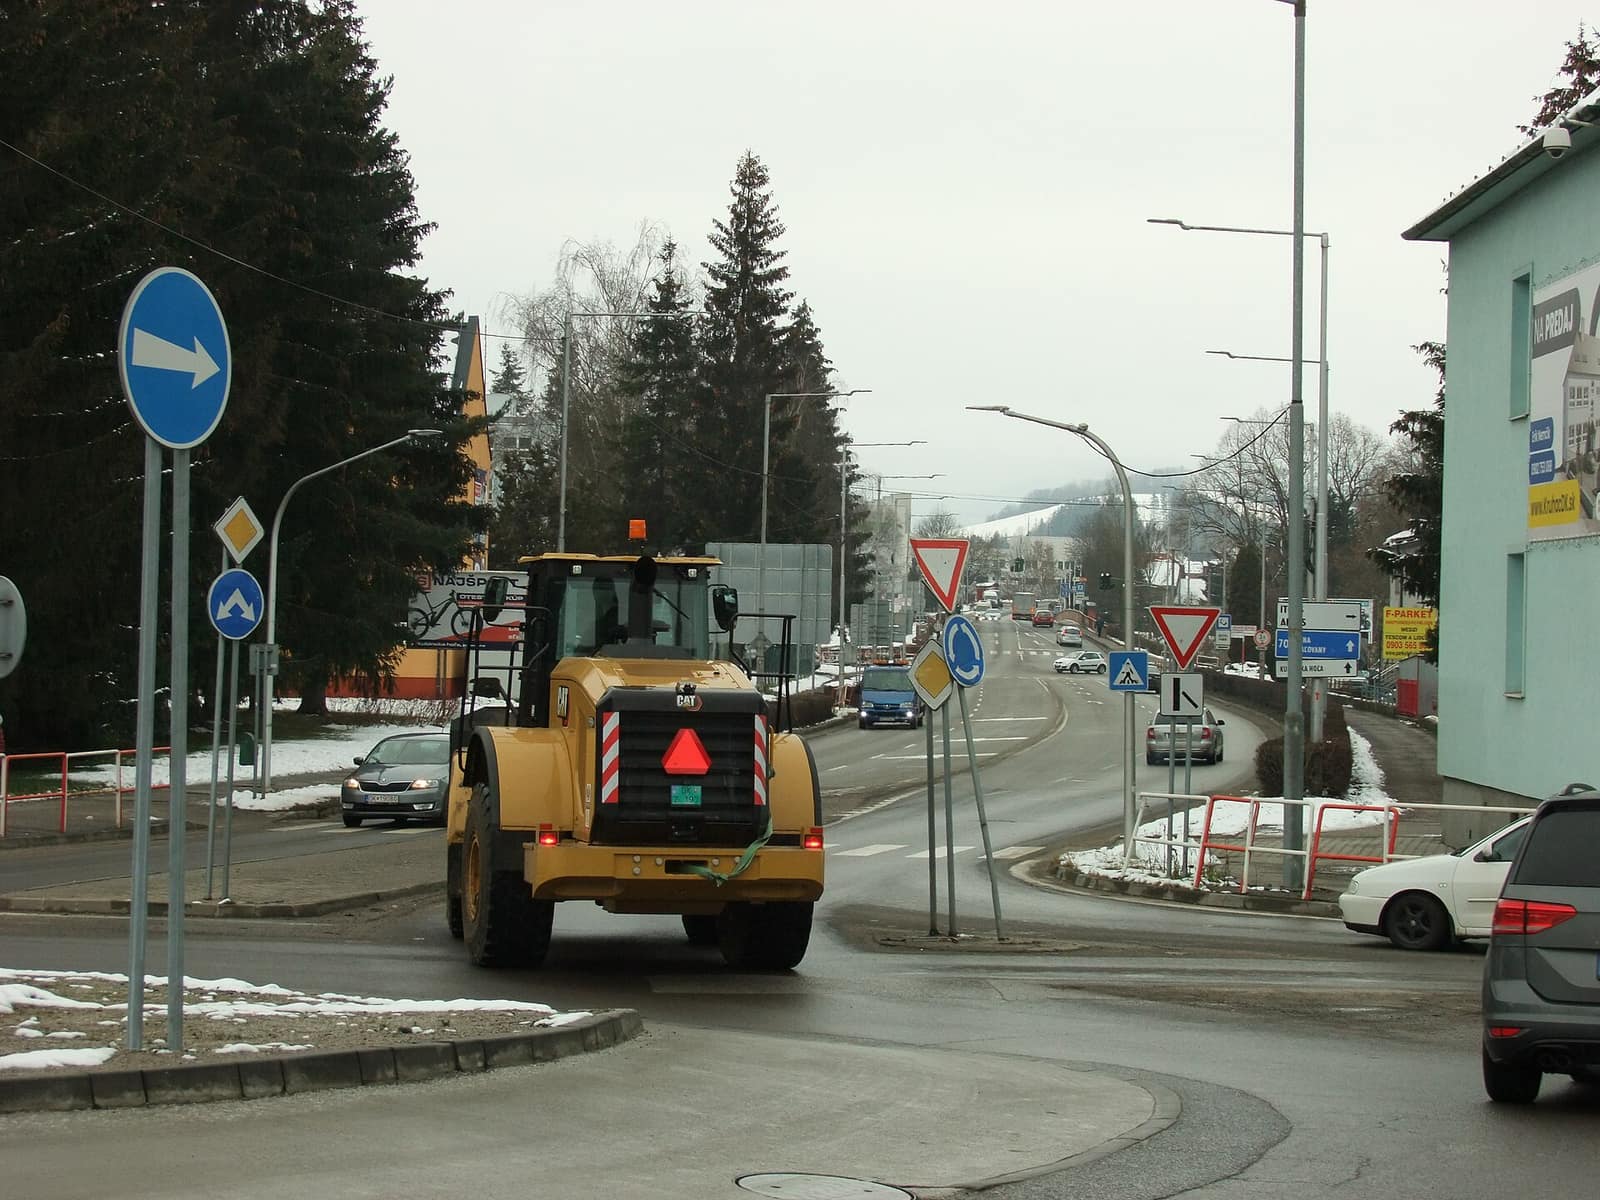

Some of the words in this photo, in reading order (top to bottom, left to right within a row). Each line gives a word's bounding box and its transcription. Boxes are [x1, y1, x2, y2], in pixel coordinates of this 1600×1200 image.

[1534, 316, 1544, 344] NA
[1545, 304, 1573, 340] PREDAJ
[557, 686, 568, 716] CAT
[676, 694, 697, 707] CAT
